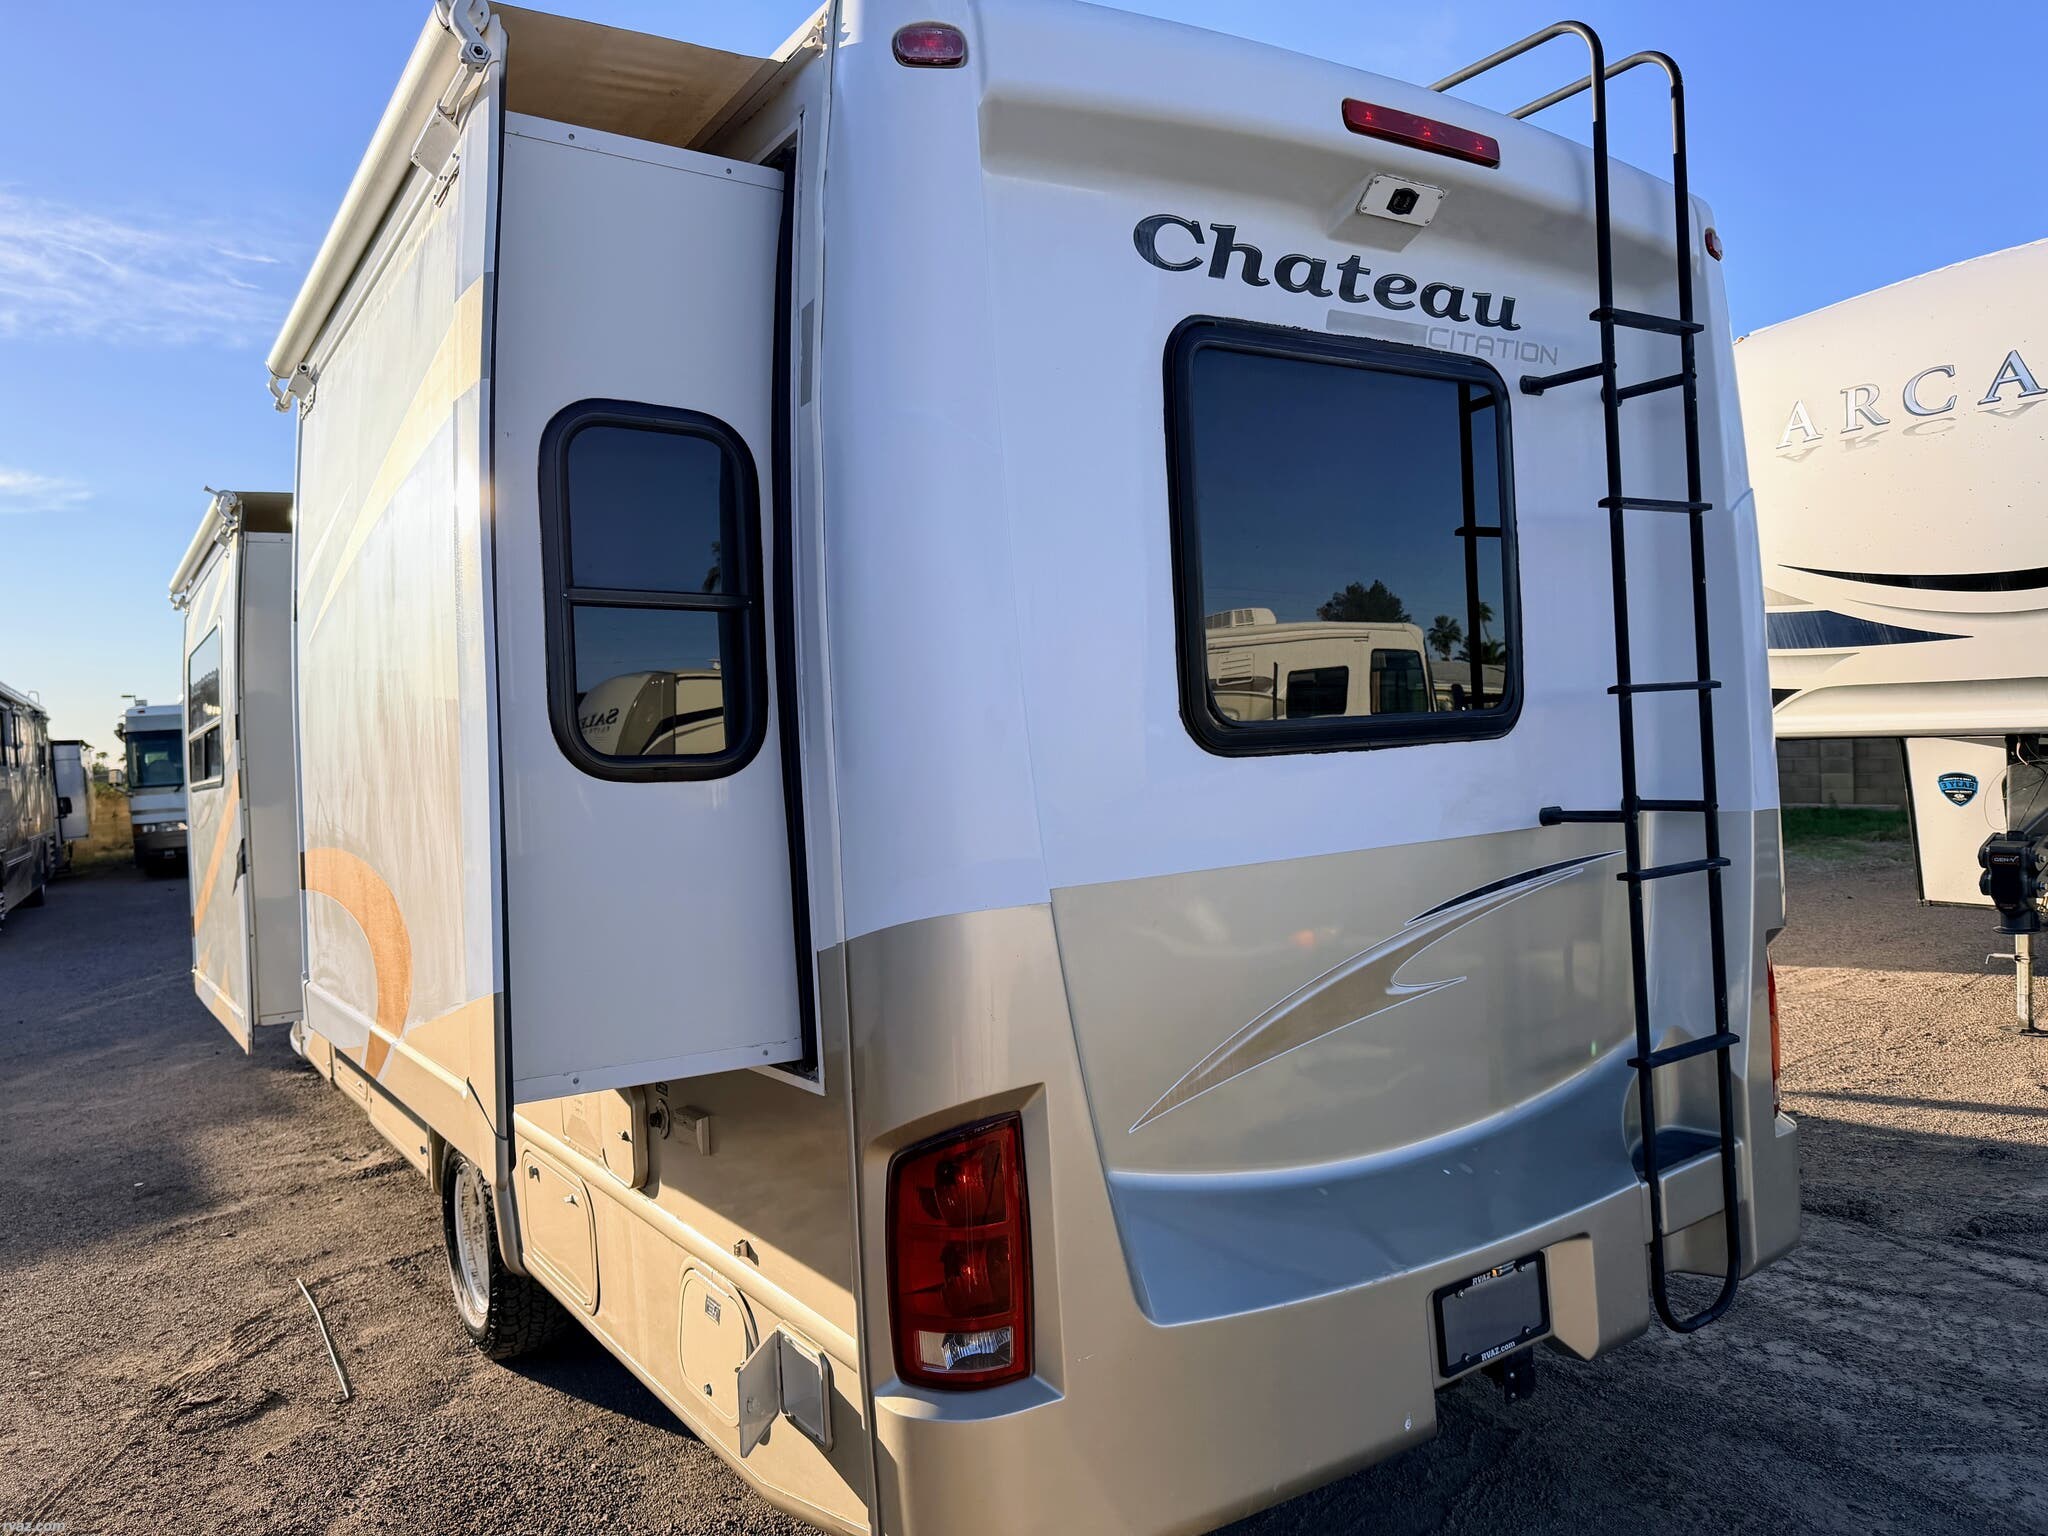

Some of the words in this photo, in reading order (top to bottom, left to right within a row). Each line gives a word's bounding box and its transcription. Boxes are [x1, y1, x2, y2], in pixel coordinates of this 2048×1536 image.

[1132, 213, 1522, 331] Chateau
[1427, 326, 1559, 366] CITATION
[1775, 349, 2048, 450] ARCA
[1950, 780, 1976, 790] YEAR
[1472, 1271, 1491, 1286] RVAZ
[1481, 1341, 1516, 1361] RVAZ.com
